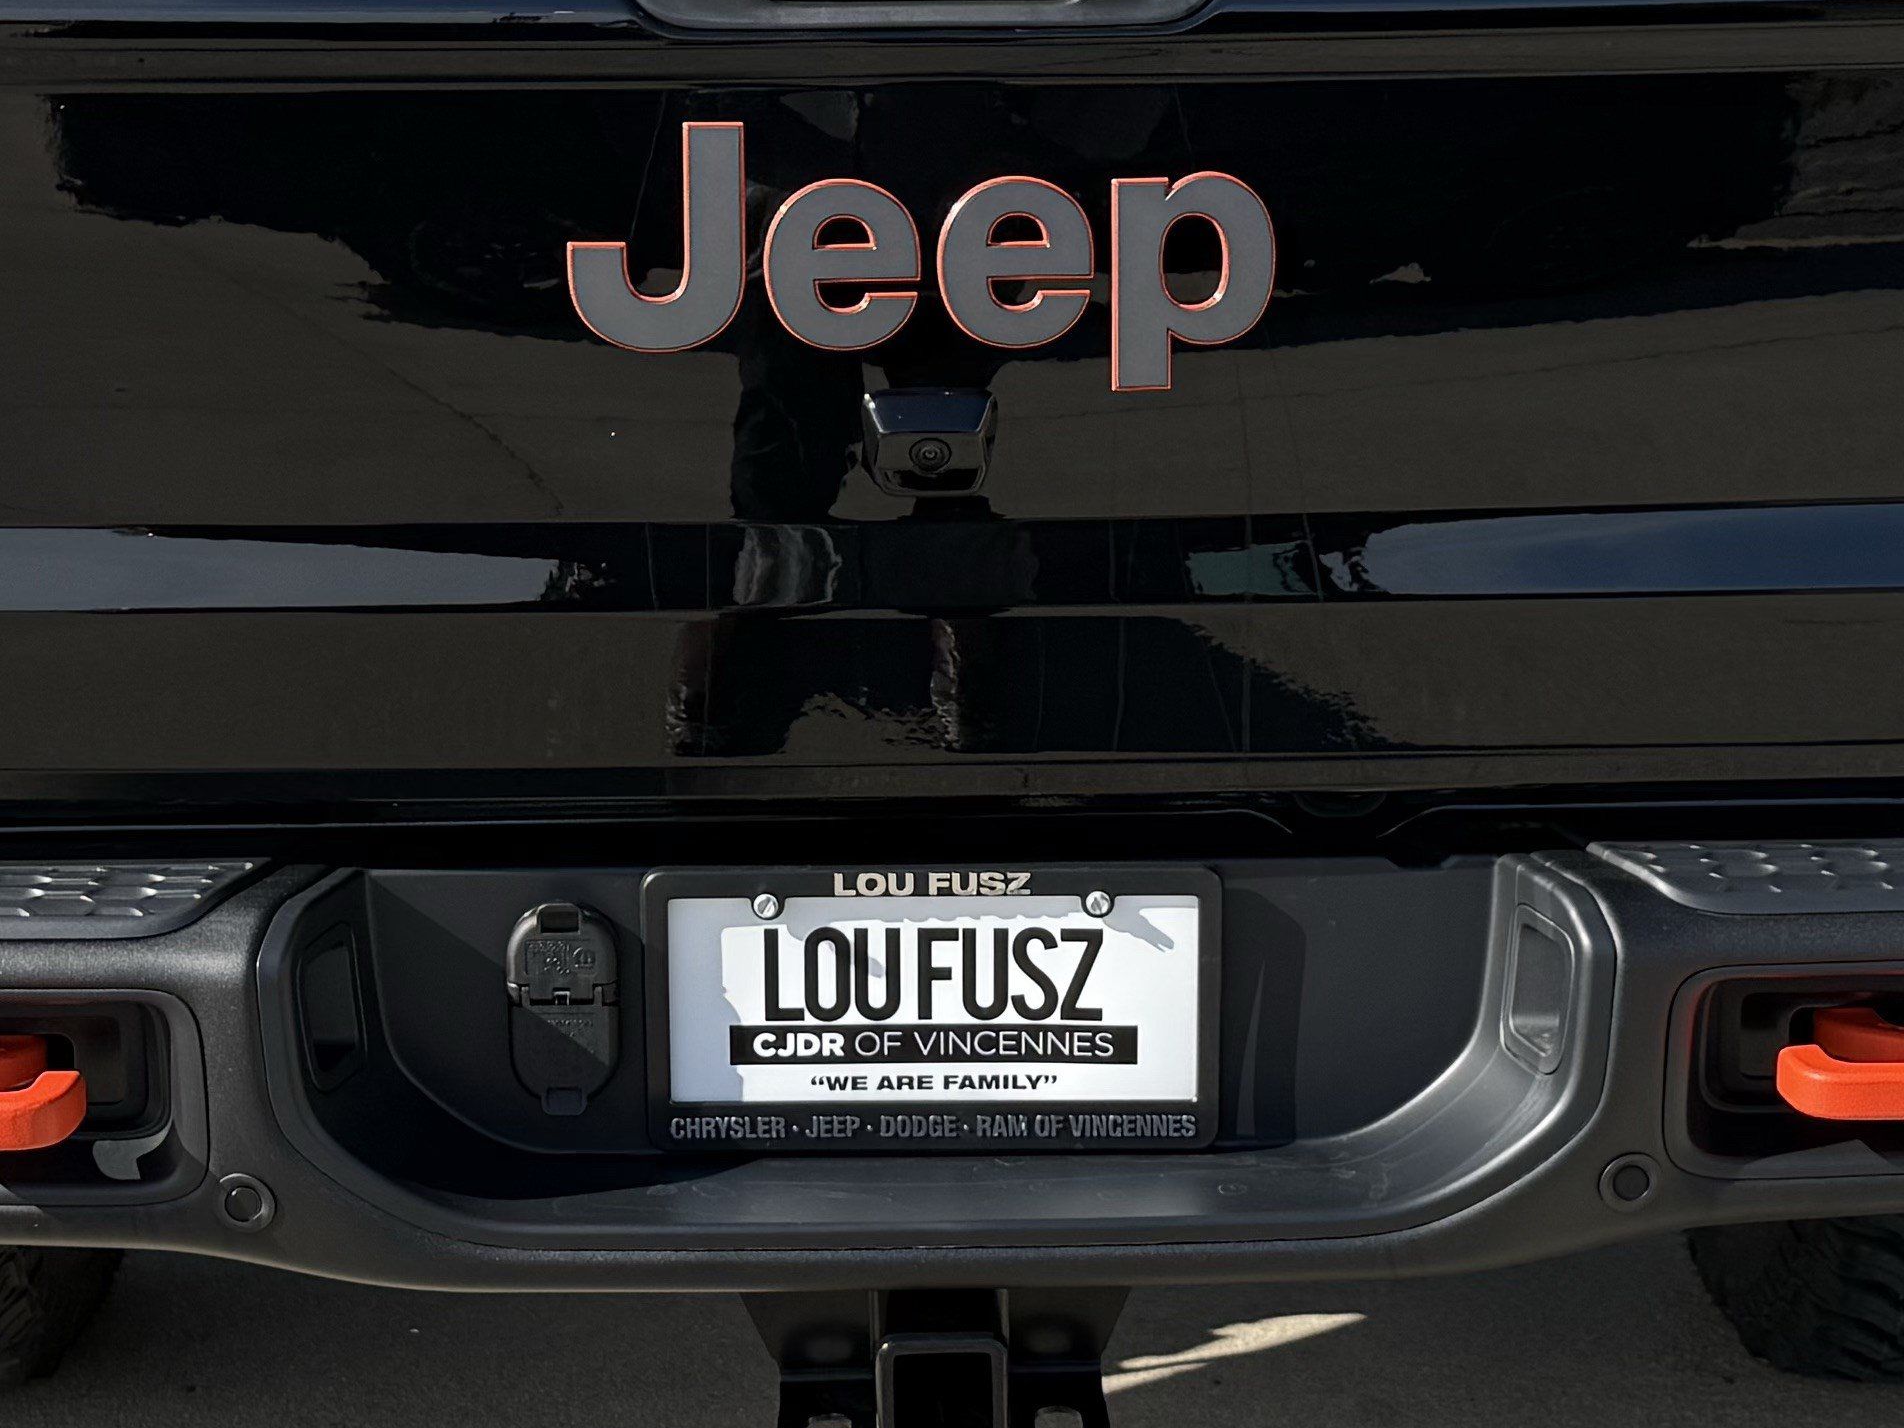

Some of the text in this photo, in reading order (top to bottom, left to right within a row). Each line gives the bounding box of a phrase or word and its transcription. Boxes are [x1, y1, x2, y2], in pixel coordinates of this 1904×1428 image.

[567, 121, 1276, 392] Jeep
[834, 871, 1032, 896] LOU FUSZ
[763, 926, 1103, 1022] LOU FUSZ
[752, 1030, 1114, 1058] CJDR OF VINCENNES
[876, 1075, 934, 1091] ARE
[670, 1113, 1196, 1140] CHRYSLER JEEP DODGE RAM OF VINCENNES
